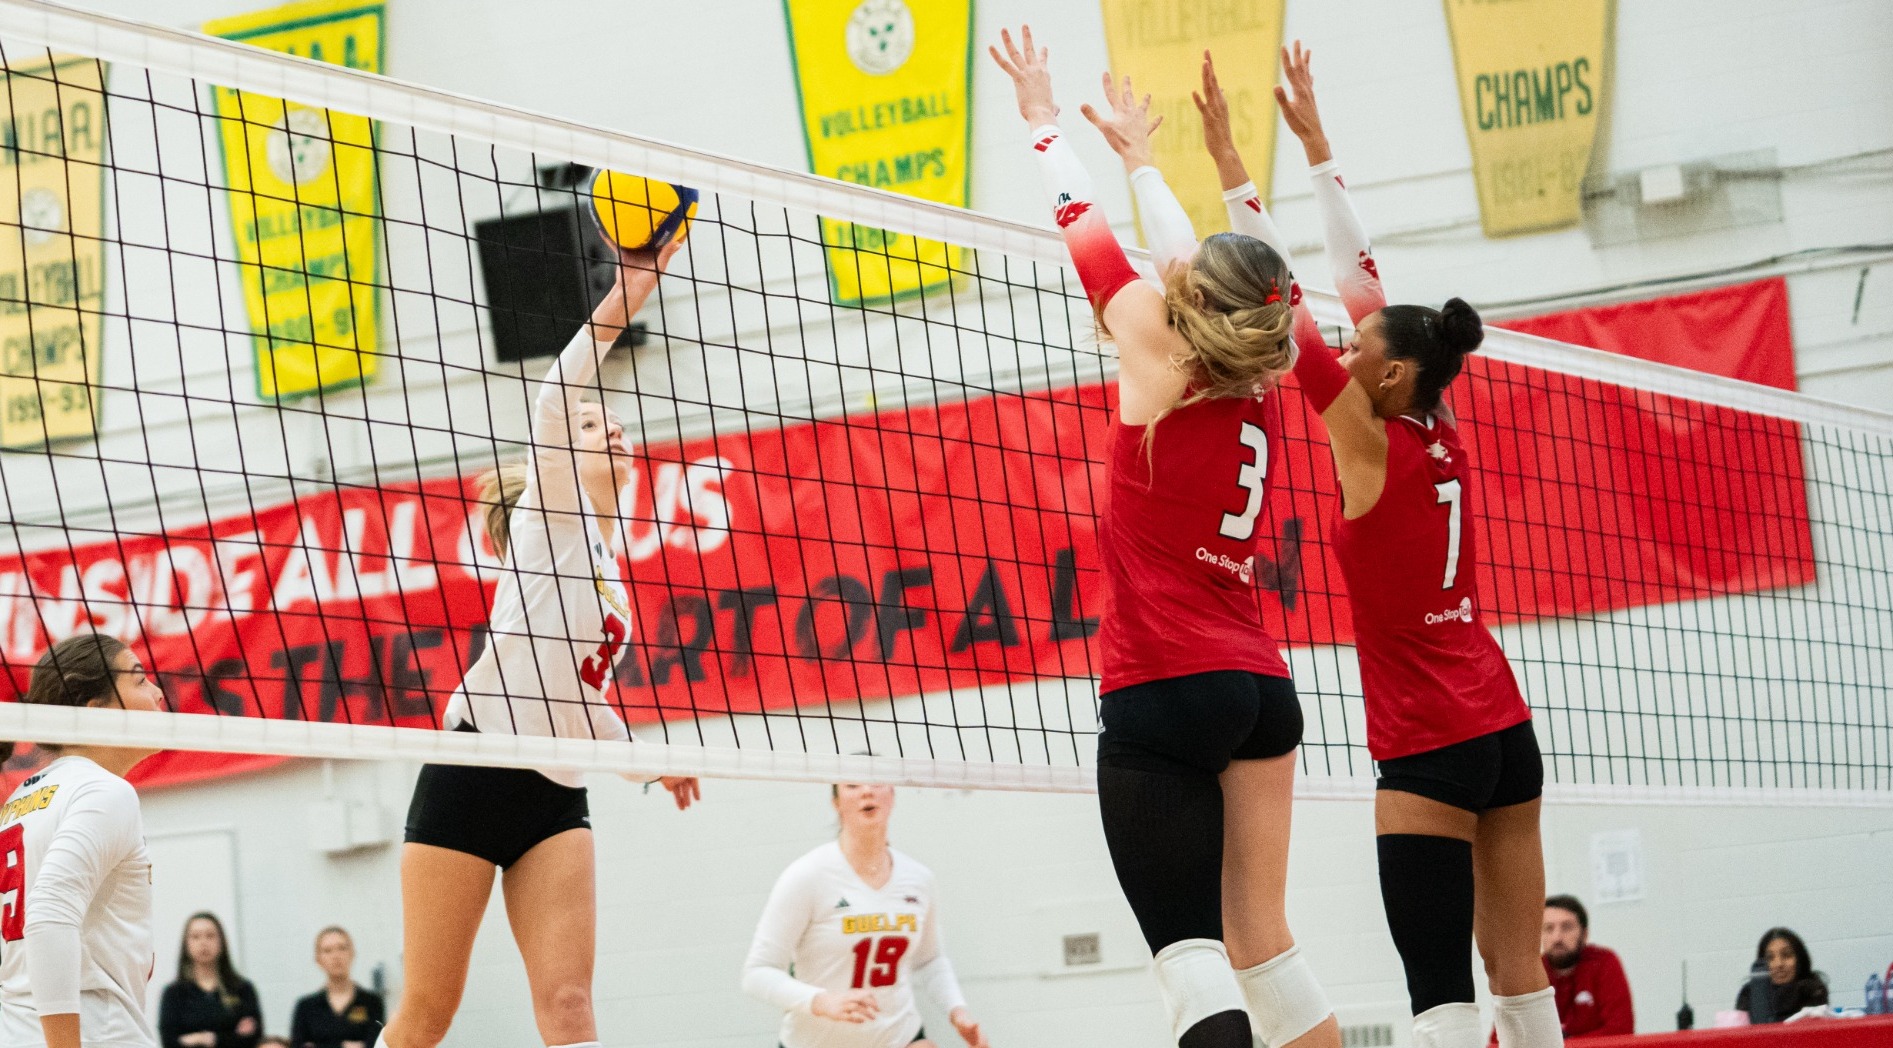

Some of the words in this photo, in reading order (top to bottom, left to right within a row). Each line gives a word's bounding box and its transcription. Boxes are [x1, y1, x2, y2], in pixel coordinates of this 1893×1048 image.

[820, 90, 954, 138] VOLLEYBALL
[1475, 56, 1593, 131] CHAMPS
[837, 147, 946, 187] CHAMPS
[1218, 420, 1268, 541] 3
[0, 529, 257, 658] INSIDE
[269, 500, 438, 612] ALL
[612, 455, 734, 561] US
[1195, 547, 1217, 565] One
[1218, 554, 1240, 575] Stop
[1434, 478, 1462, 590] 7
[269, 626, 445, 723] THE
[795, 566, 931, 664] OF
[950, 555, 1021, 654] A
[1425, 612, 1444, 625] One
[1443, 609, 1460, 622] Stop
[851, 935, 911, 988] 19
